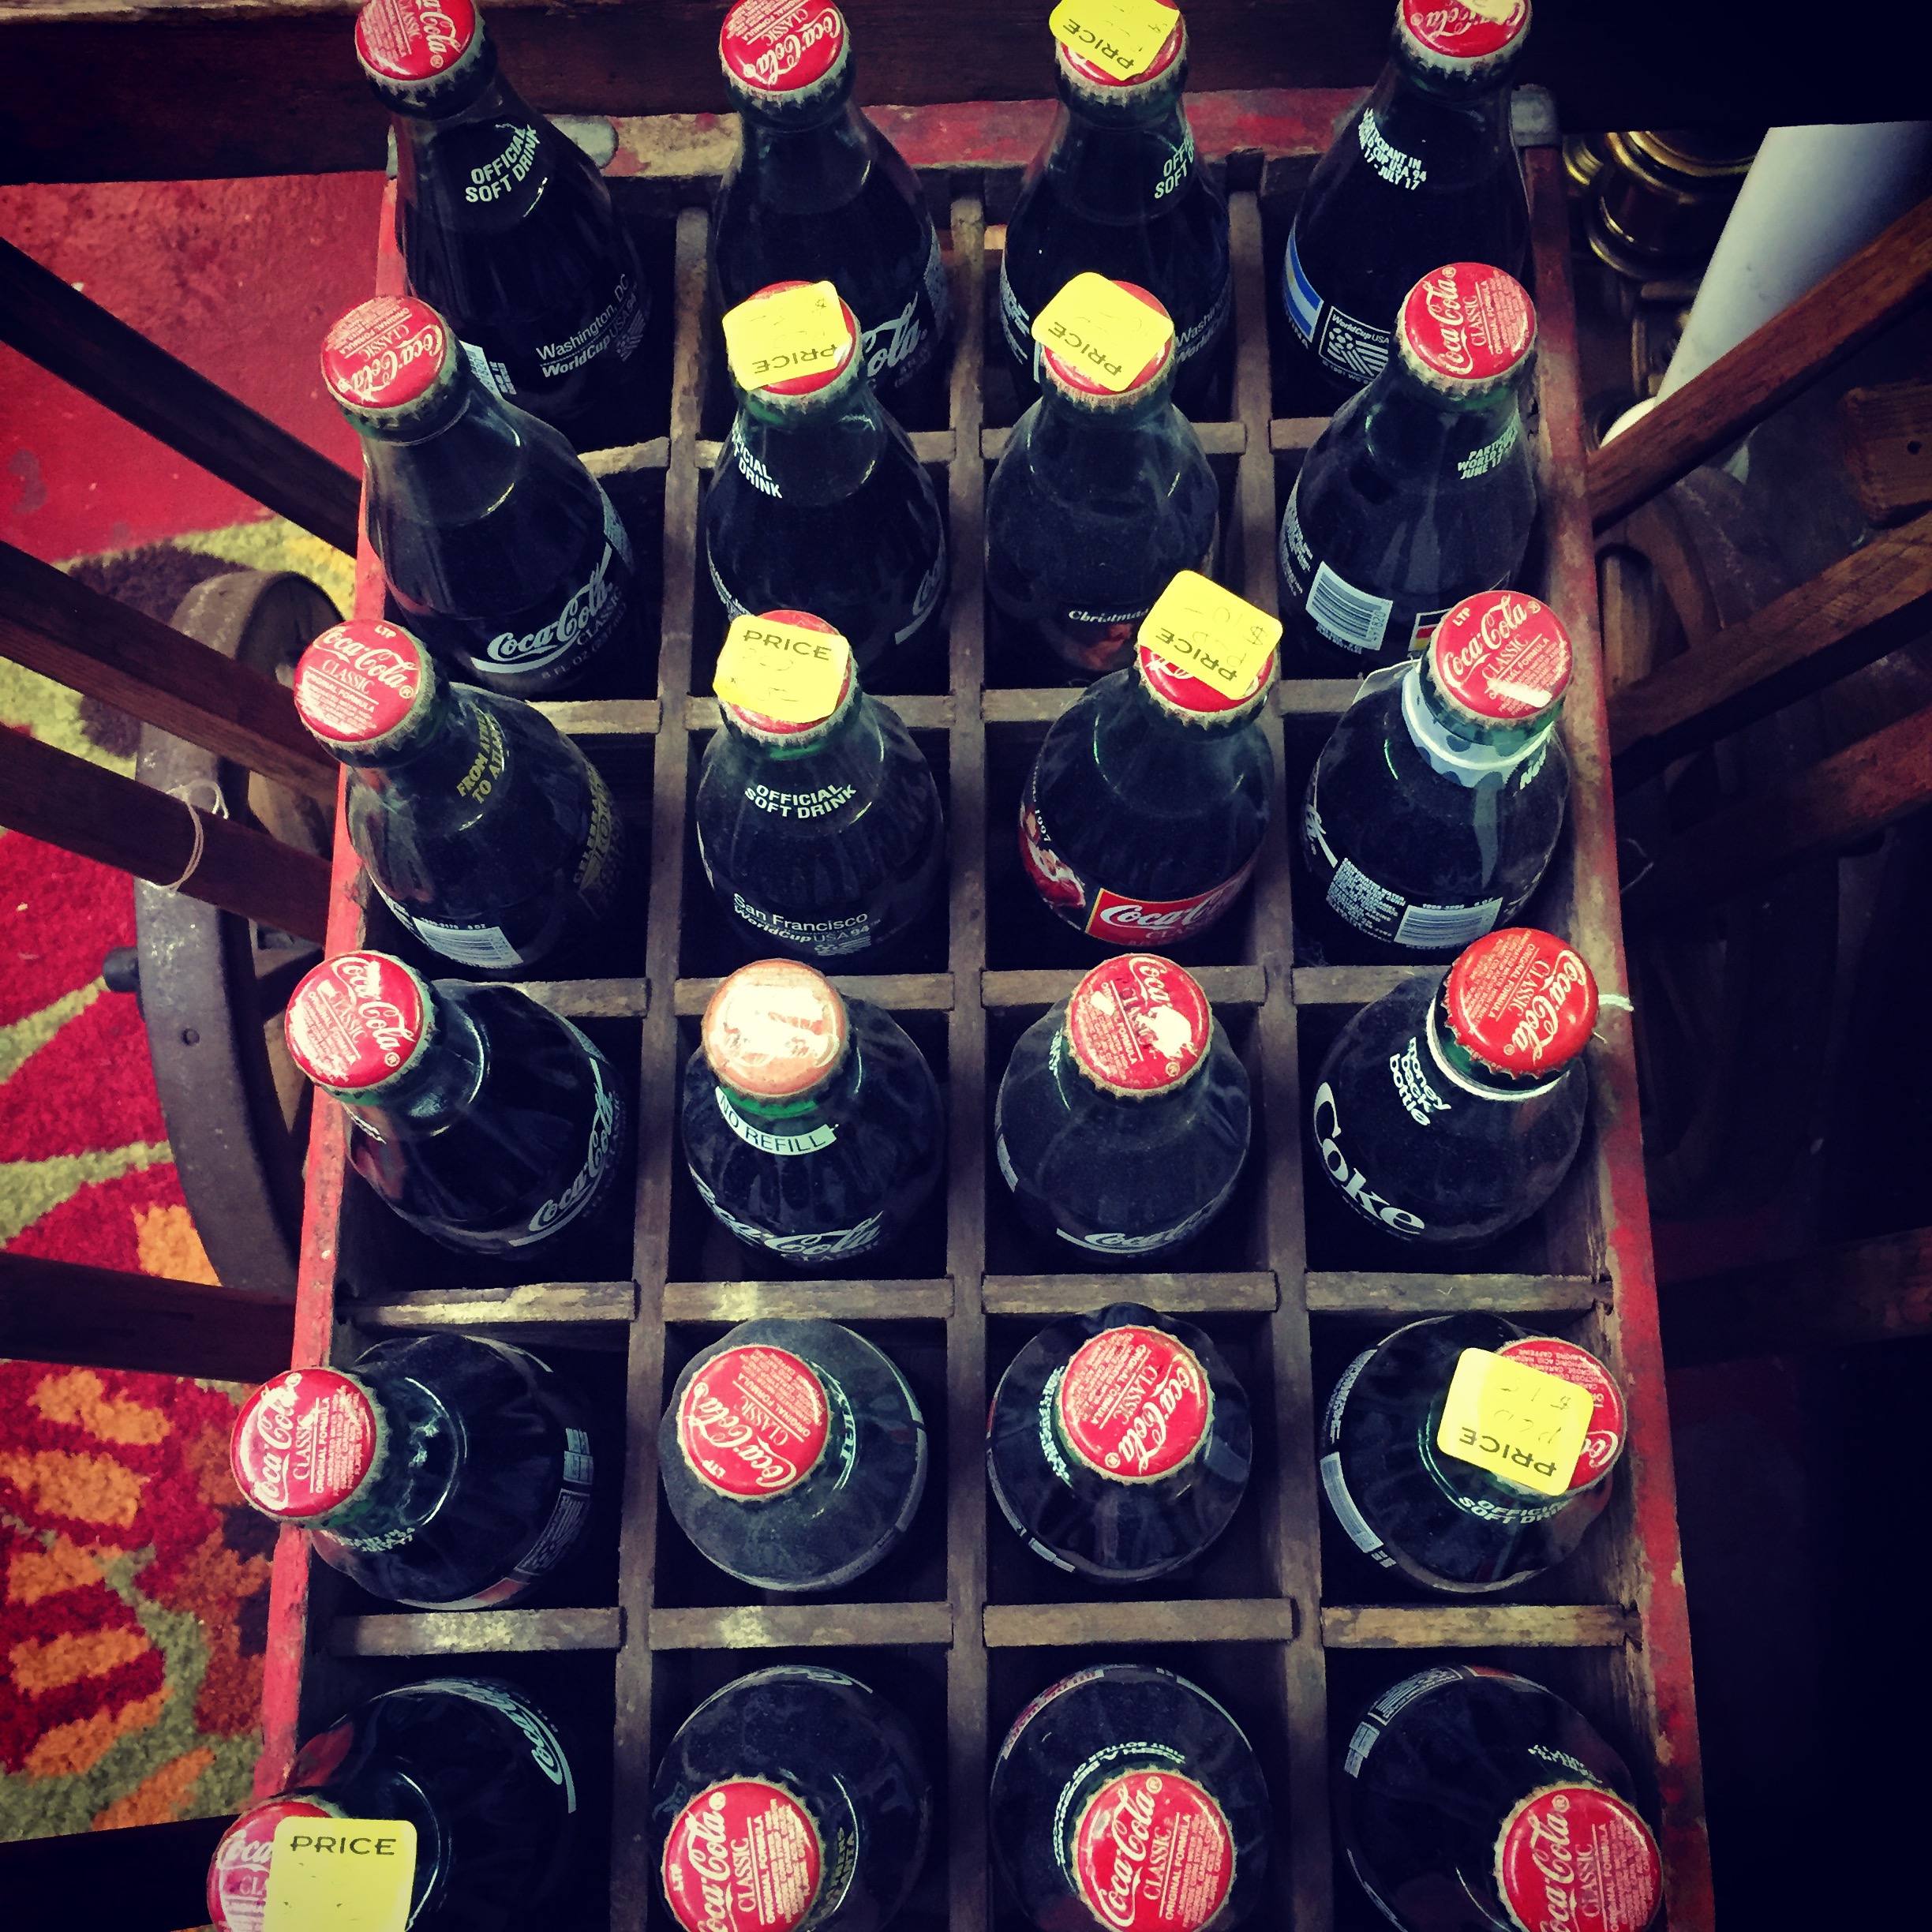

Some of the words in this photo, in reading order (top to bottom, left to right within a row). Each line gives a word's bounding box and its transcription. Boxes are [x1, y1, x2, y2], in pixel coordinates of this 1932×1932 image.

[762, 9, 809, 46] CLASSIC
[1063, 18, 1134, 69] PRICE
[465, 178, 515, 203] SOFT
[513, 124, 541, 182] DRINK
[471, 126, 528, 185] OFFICIAL
[1389, 159, 1409, 177] USA
[1413, 170, 1427, 182] 94
[1408, 157, 1421, 170] IN
[1155, 159, 1187, 199] SOFT
[1378, 166, 1402, 185] JULY
[1406, 178, 1420, 190] 17
[536, 304, 618, 361] Washington,
[613, 273, 630, 302] DC
[1331, 314, 1373, 341] WorldCup
[1371, 331, 1391, 345] USA
[1462, 295, 1486, 346] CLASSIC
[358, 324, 410, 362] CLASSIC
[541, 335, 611, 377] WorldCup
[608, 309, 629, 339] USA
[752, 343, 837, 374] PRICE
[1047, 320, 1122, 376] PRICE
[738, 455, 783, 499] DRINK
[1458, 452, 1496, 472] WORLD
[1461, 466, 1488, 480] JUNE
[374, 624, 396, 638] LTP
[1452, 607, 1470, 626] LTP
[743, 630, 831, 661] PRICE
[1155, 626, 1238, 682] PRICE
[1481, 634, 1531, 683] CLASSIC
[1517, 638, 1549, 669] FORMULA
[321, 659, 373, 694] CLASSIC
[337, 688, 374, 712] FORMULA
[456, 751, 489, 797] FROM
[472, 779, 492, 804] TO
[744, 787, 792, 818] SOFT
[797, 784, 857, 820] DRINK
[755, 784, 843, 807] OFFICIAL
[1035, 809, 1053, 843] 1997
[733, 893, 767, 921] San
[773, 912, 869, 933] Francisco
[733, 904, 813, 944] WorldCup
[812, 930, 850, 943] USA
[1510, 943, 1535, 978] ORIGINAL
[1488, 979, 1514, 1017] FORMULA
[1507, 960, 1550, 1016] CLASSIC
[1513, 950, 1587, 1065] Coca-Cola
[1116, 1022, 1136, 1064] FORMULA
[1388, 1052, 1432, 1126] bottle
[1401, 1054, 1435, 1114] back
[1407, 1035, 1453, 1112] money
[719, 1094, 739, 1129] NO
[744, 1125, 827, 1153] REFILL
[1313, 1081, 1426, 1235] Coke
[738, 1373, 775, 1406] FORMULA
[1090, 1383, 1121, 1424] FORMULA
[1113, 1365, 1157, 1424] CLASSIC
[740, 1395, 788, 1446] CLASSIC
[776, 1403, 811, 1437] ORIGINAL
[688, 1397, 796, 1488] Coca-Cola
[1458, 1425, 1559, 1477] PRICE
[315, 1447, 326, 1493] ORIGINAL
[702, 1459, 726, 1479] LTP
[1458, 1496, 1518, 1525] SOFT
[290, 1835, 397, 1856] PRICE
[1099, 1784, 1157, 1927] Coca-Cola
[1144, 1826, 1171, 1900] CLASSIC
[669, 1863, 683, 1891] LTP
[730, 1837, 756, 1911] CLASSIC
[1165, 1870, 1181, 1919] ORIGINAL
[1174, 1814, 1191, 1866] FORMULA
[1576, 1844, 1600, 1917] CLASSIC
